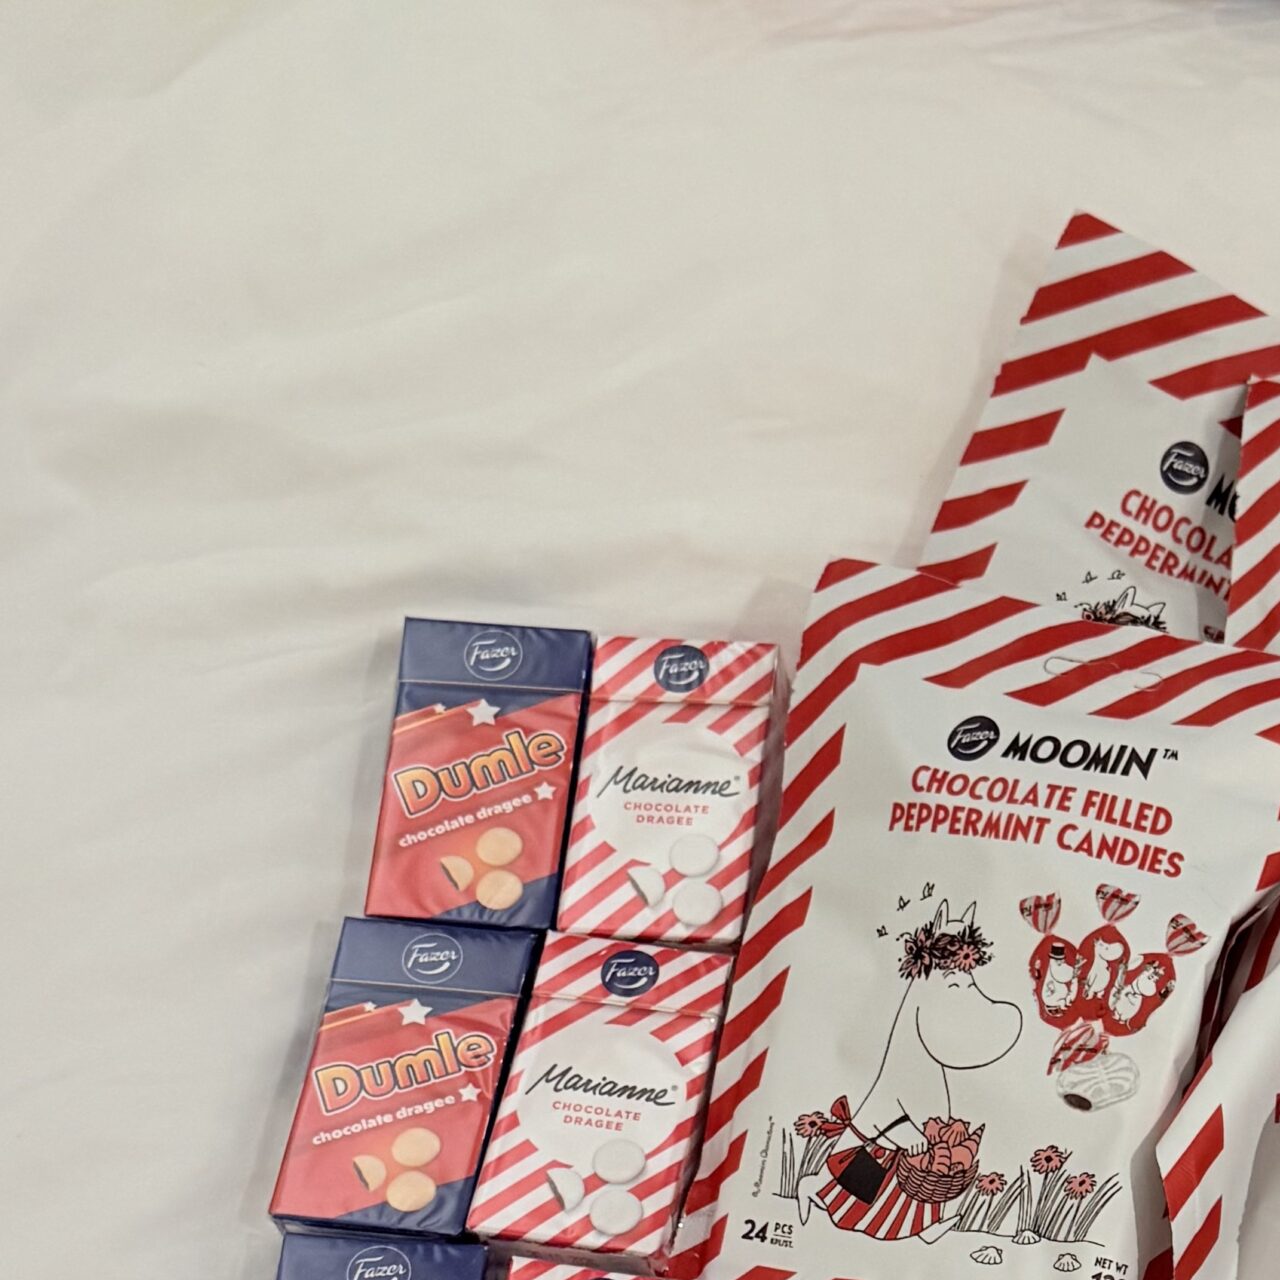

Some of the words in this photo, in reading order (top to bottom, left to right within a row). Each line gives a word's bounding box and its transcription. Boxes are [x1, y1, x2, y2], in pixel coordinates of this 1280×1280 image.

[1167, 450, 1207, 480] Fazer
[471, 642, 520, 664] Fazer
[659, 655, 707, 678] Fazer
[953, 727, 997, 754] Fazer
[394, 729, 565, 818] Dumle
[623, 801, 710, 815] CHOCOLATE
[911, 765, 1077, 812] CHOCOLATE
[1081, 790, 1173, 837] FILLED
[399, 806, 475, 848] chocolate
[475, 792, 533, 825] dragee
[635, 813, 694, 826] DRAGEE
[889, 803, 1051, 845] PEPPERMINT
[1057, 823, 1186, 879] CANDIES
[410, 944, 459, 967] Fazer
[605, 958, 657, 980] Fazer
[315, 1029, 498, 1114] Dumle
[312, 1114, 395, 1146] chocolate
[395, 1095, 456, 1122] dragee
[552, 1100, 642, 1122] CHOCOLATE
[563, 1114, 624, 1132] DRAGEE
[741, 1219, 769, 1242] 24
[774, 1222, 793, 1235] PCS
[353, 1256, 406, 1279] Fazer
[1094, 1257, 1113, 1270] NET
[1116, 1262, 1128, 1275] WT
